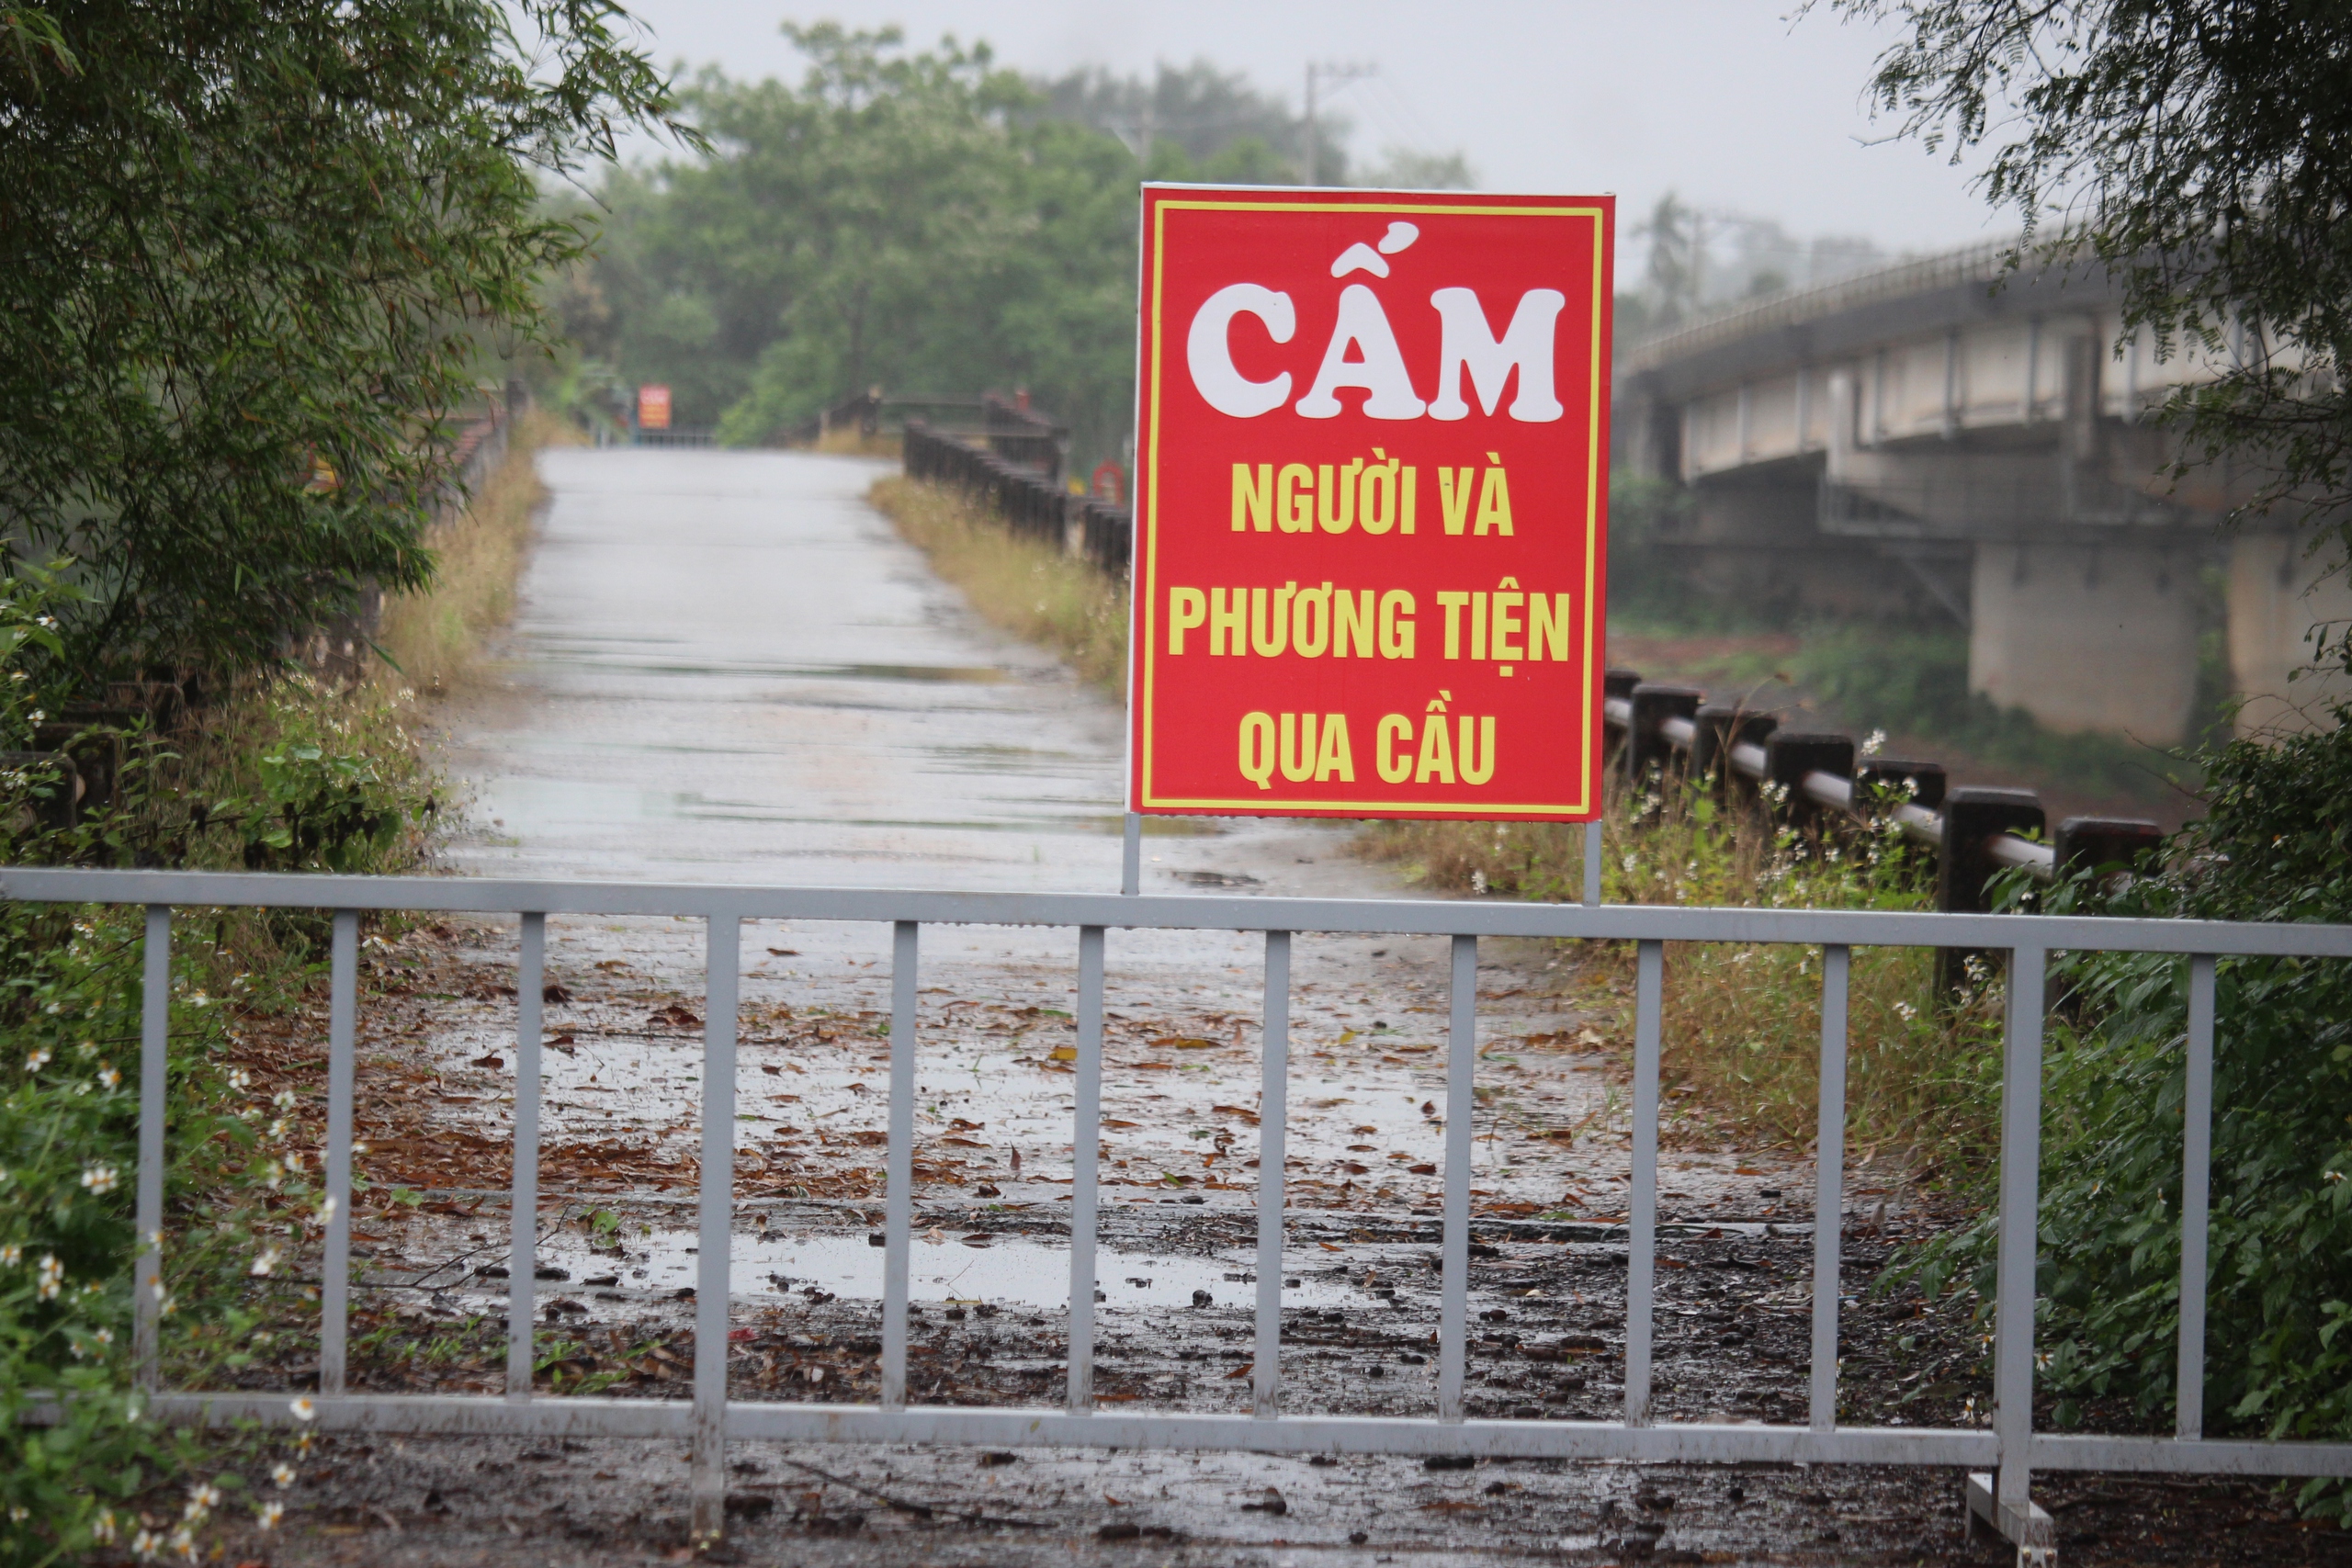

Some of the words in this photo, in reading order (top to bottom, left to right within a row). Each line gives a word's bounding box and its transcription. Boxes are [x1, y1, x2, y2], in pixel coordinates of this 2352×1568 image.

[1187, 221, 1565, 422] CẤM
[1232, 447, 1416, 535] NGƯỜI
[1438, 452, 1513, 536] VÀ
[1169, 581, 1415, 659] PHƯƠNG
[1437, 577, 1569, 679] TIỆN
[1239, 711, 1354, 789] QUA
[1376, 690, 1495, 784] CẦU
